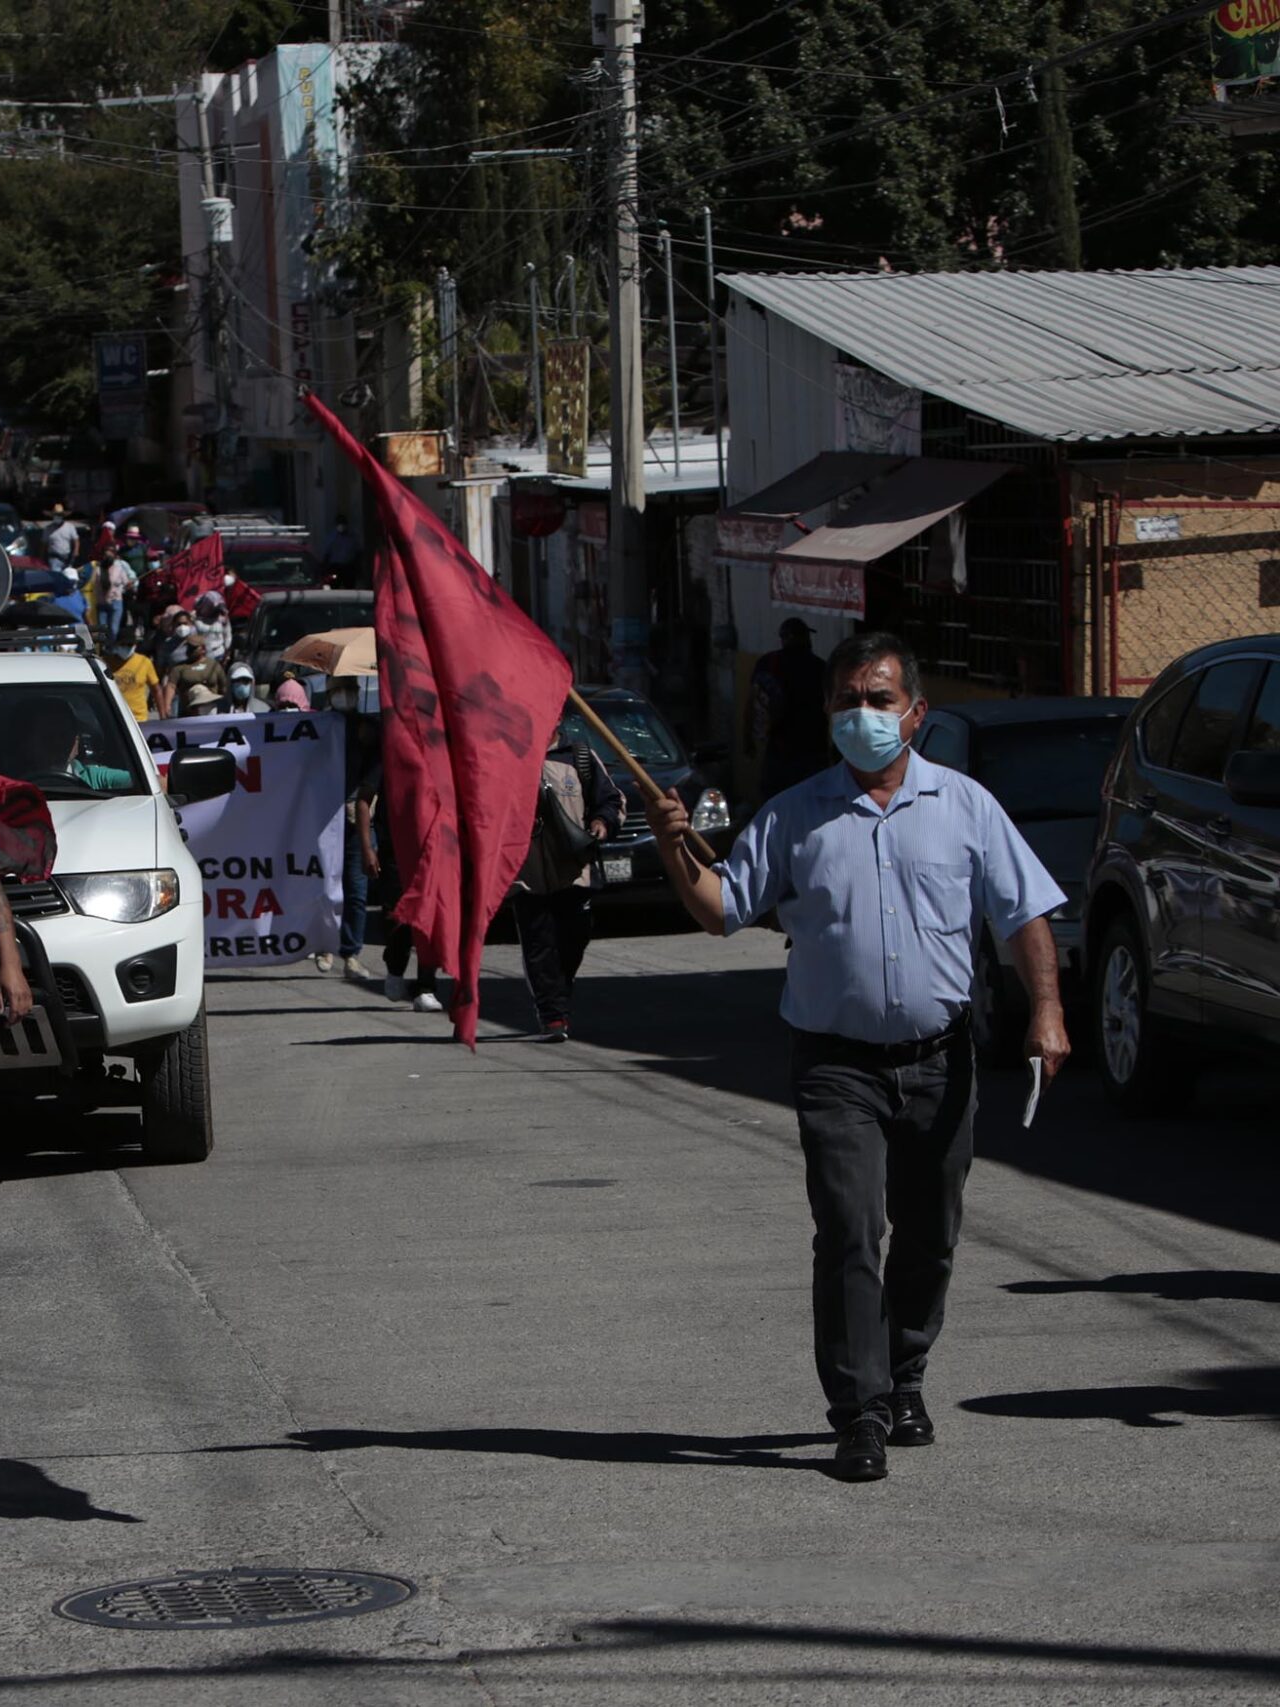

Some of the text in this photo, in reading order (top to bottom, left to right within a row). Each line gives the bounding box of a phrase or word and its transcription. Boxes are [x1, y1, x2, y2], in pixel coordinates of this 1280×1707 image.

[101, 344, 138, 366] WC
[218, 727, 246, 747] A
[265, 720, 319, 743] LA
[200, 853, 324, 880] CON LA
[205, 932, 306, 957] RERO
